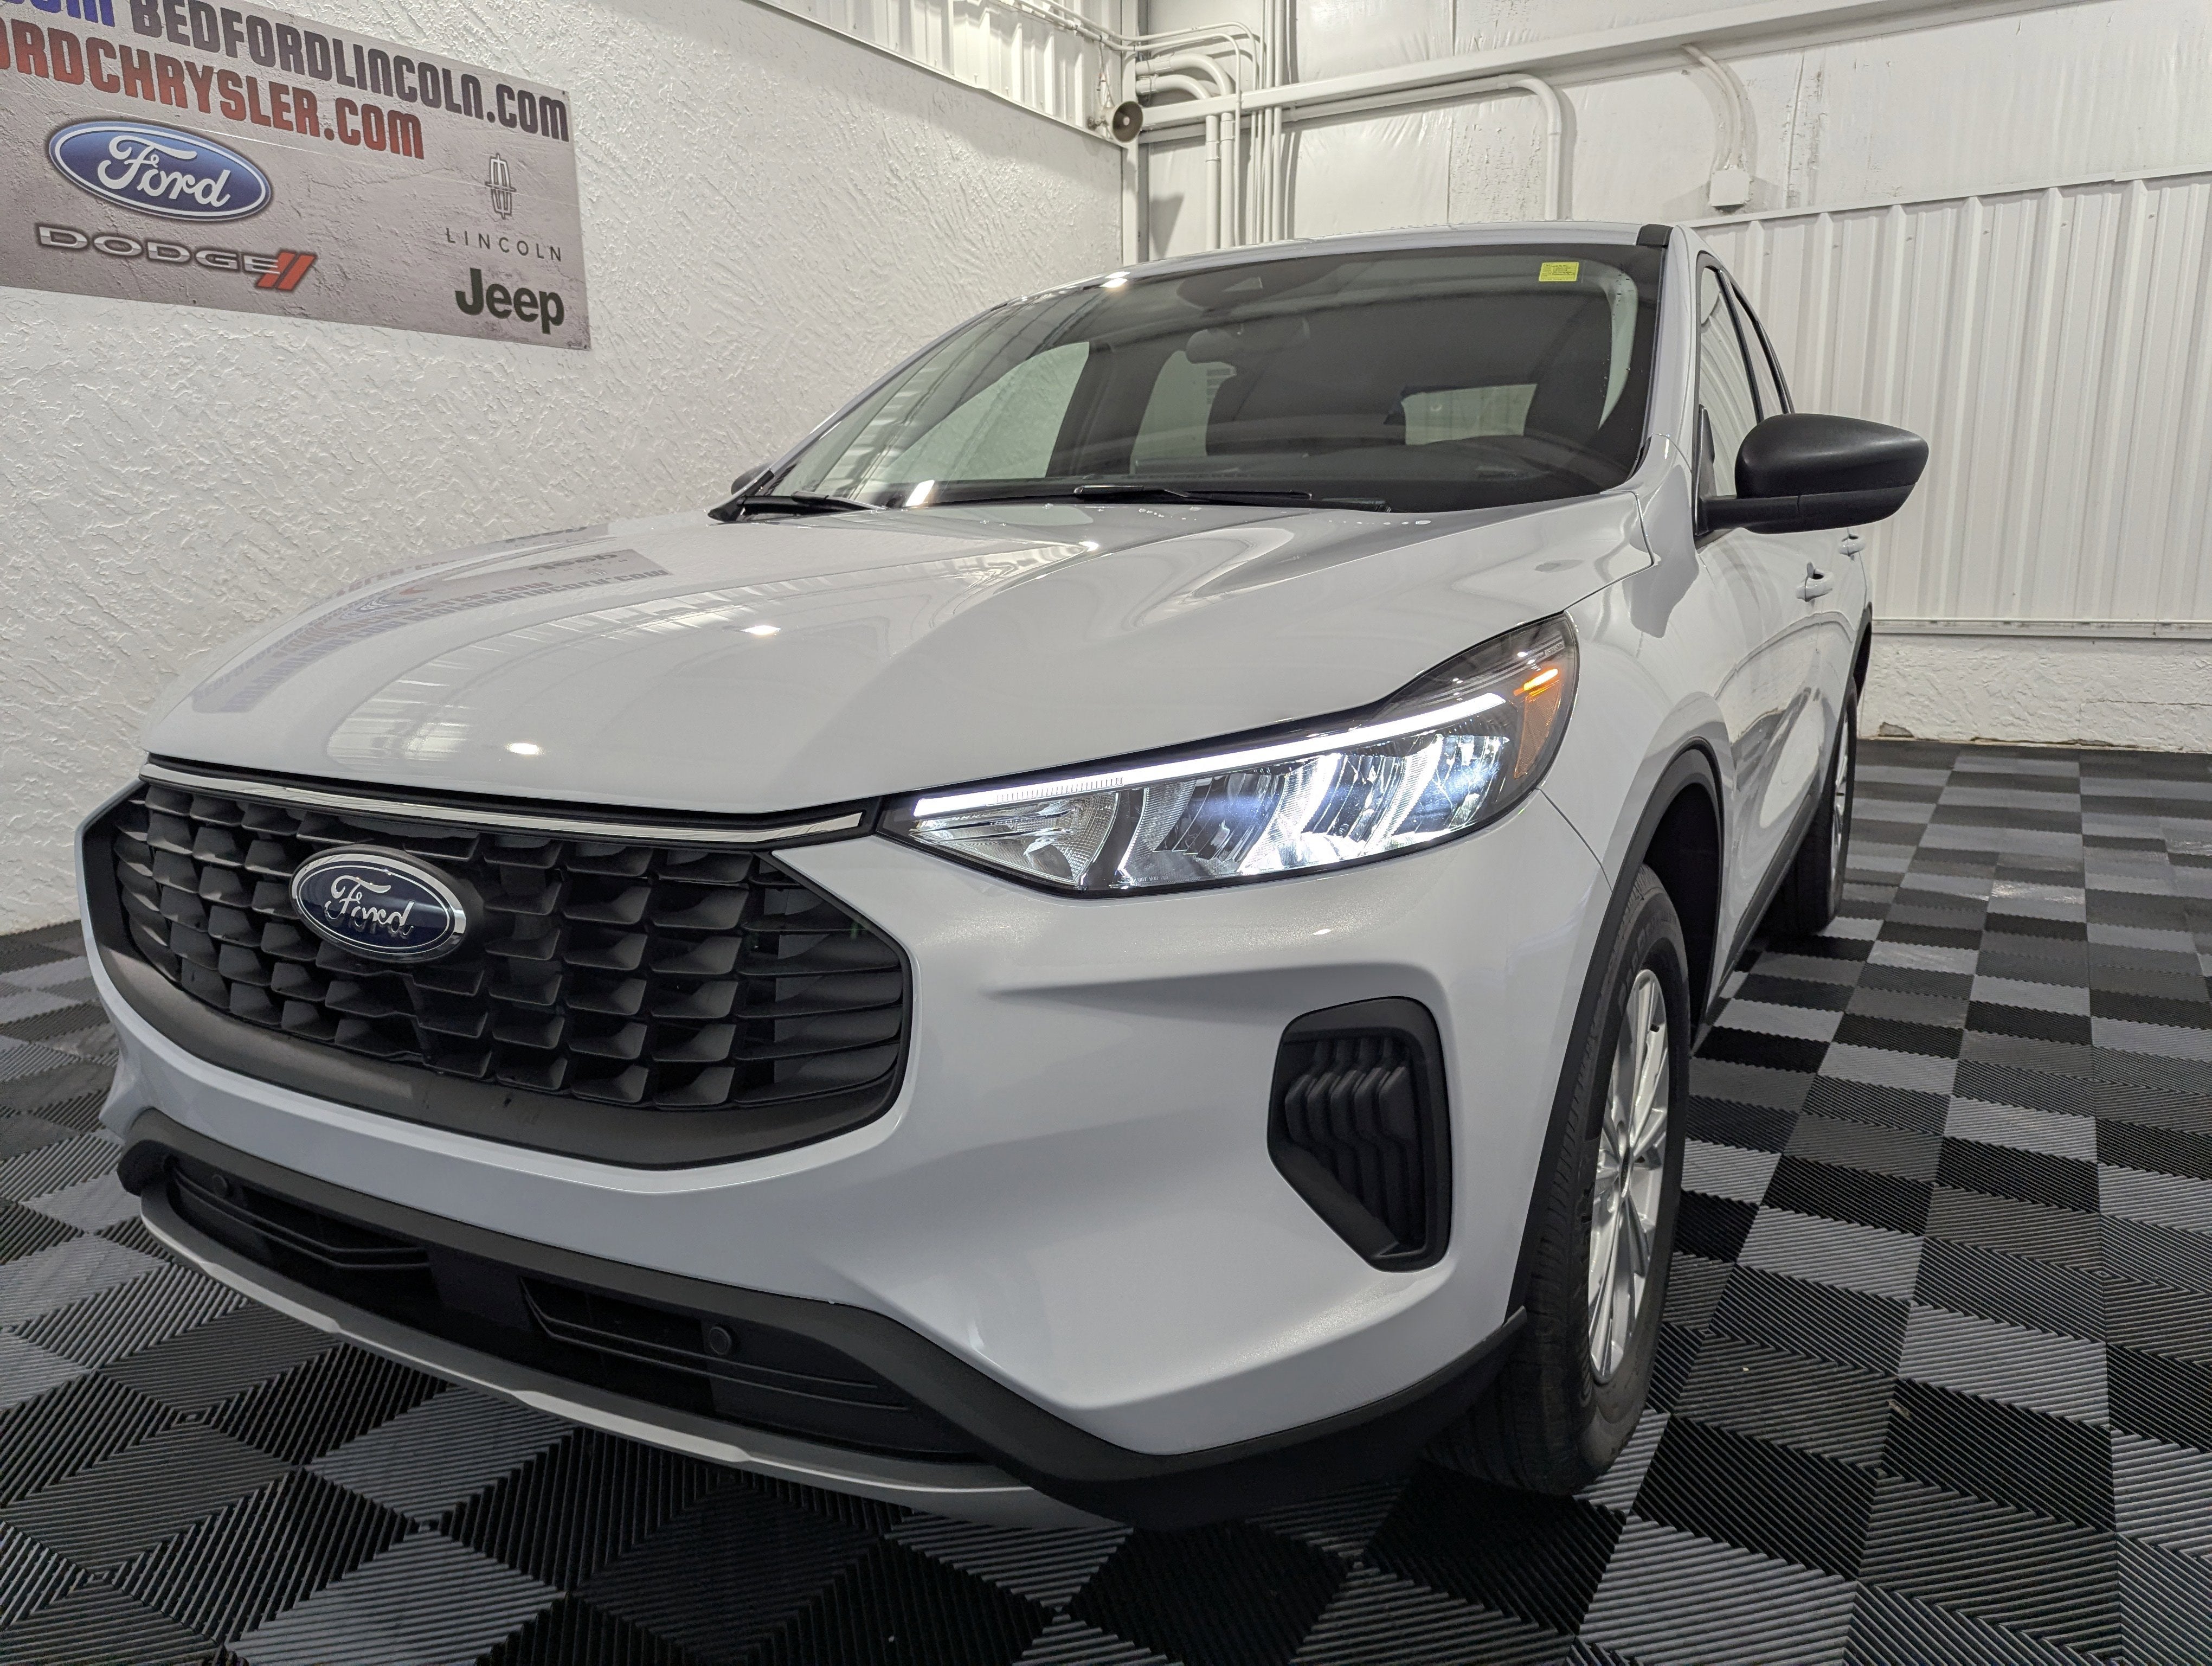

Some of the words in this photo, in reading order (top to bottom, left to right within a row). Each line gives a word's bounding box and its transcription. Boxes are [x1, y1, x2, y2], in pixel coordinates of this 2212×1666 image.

[97, 135, 232, 207] Ford
[38, 226, 280, 274] DODGE
[446, 227, 562, 262] LINCOLN
[454, 267, 565, 335] Jeep
[324, 875, 415, 937] Ford
